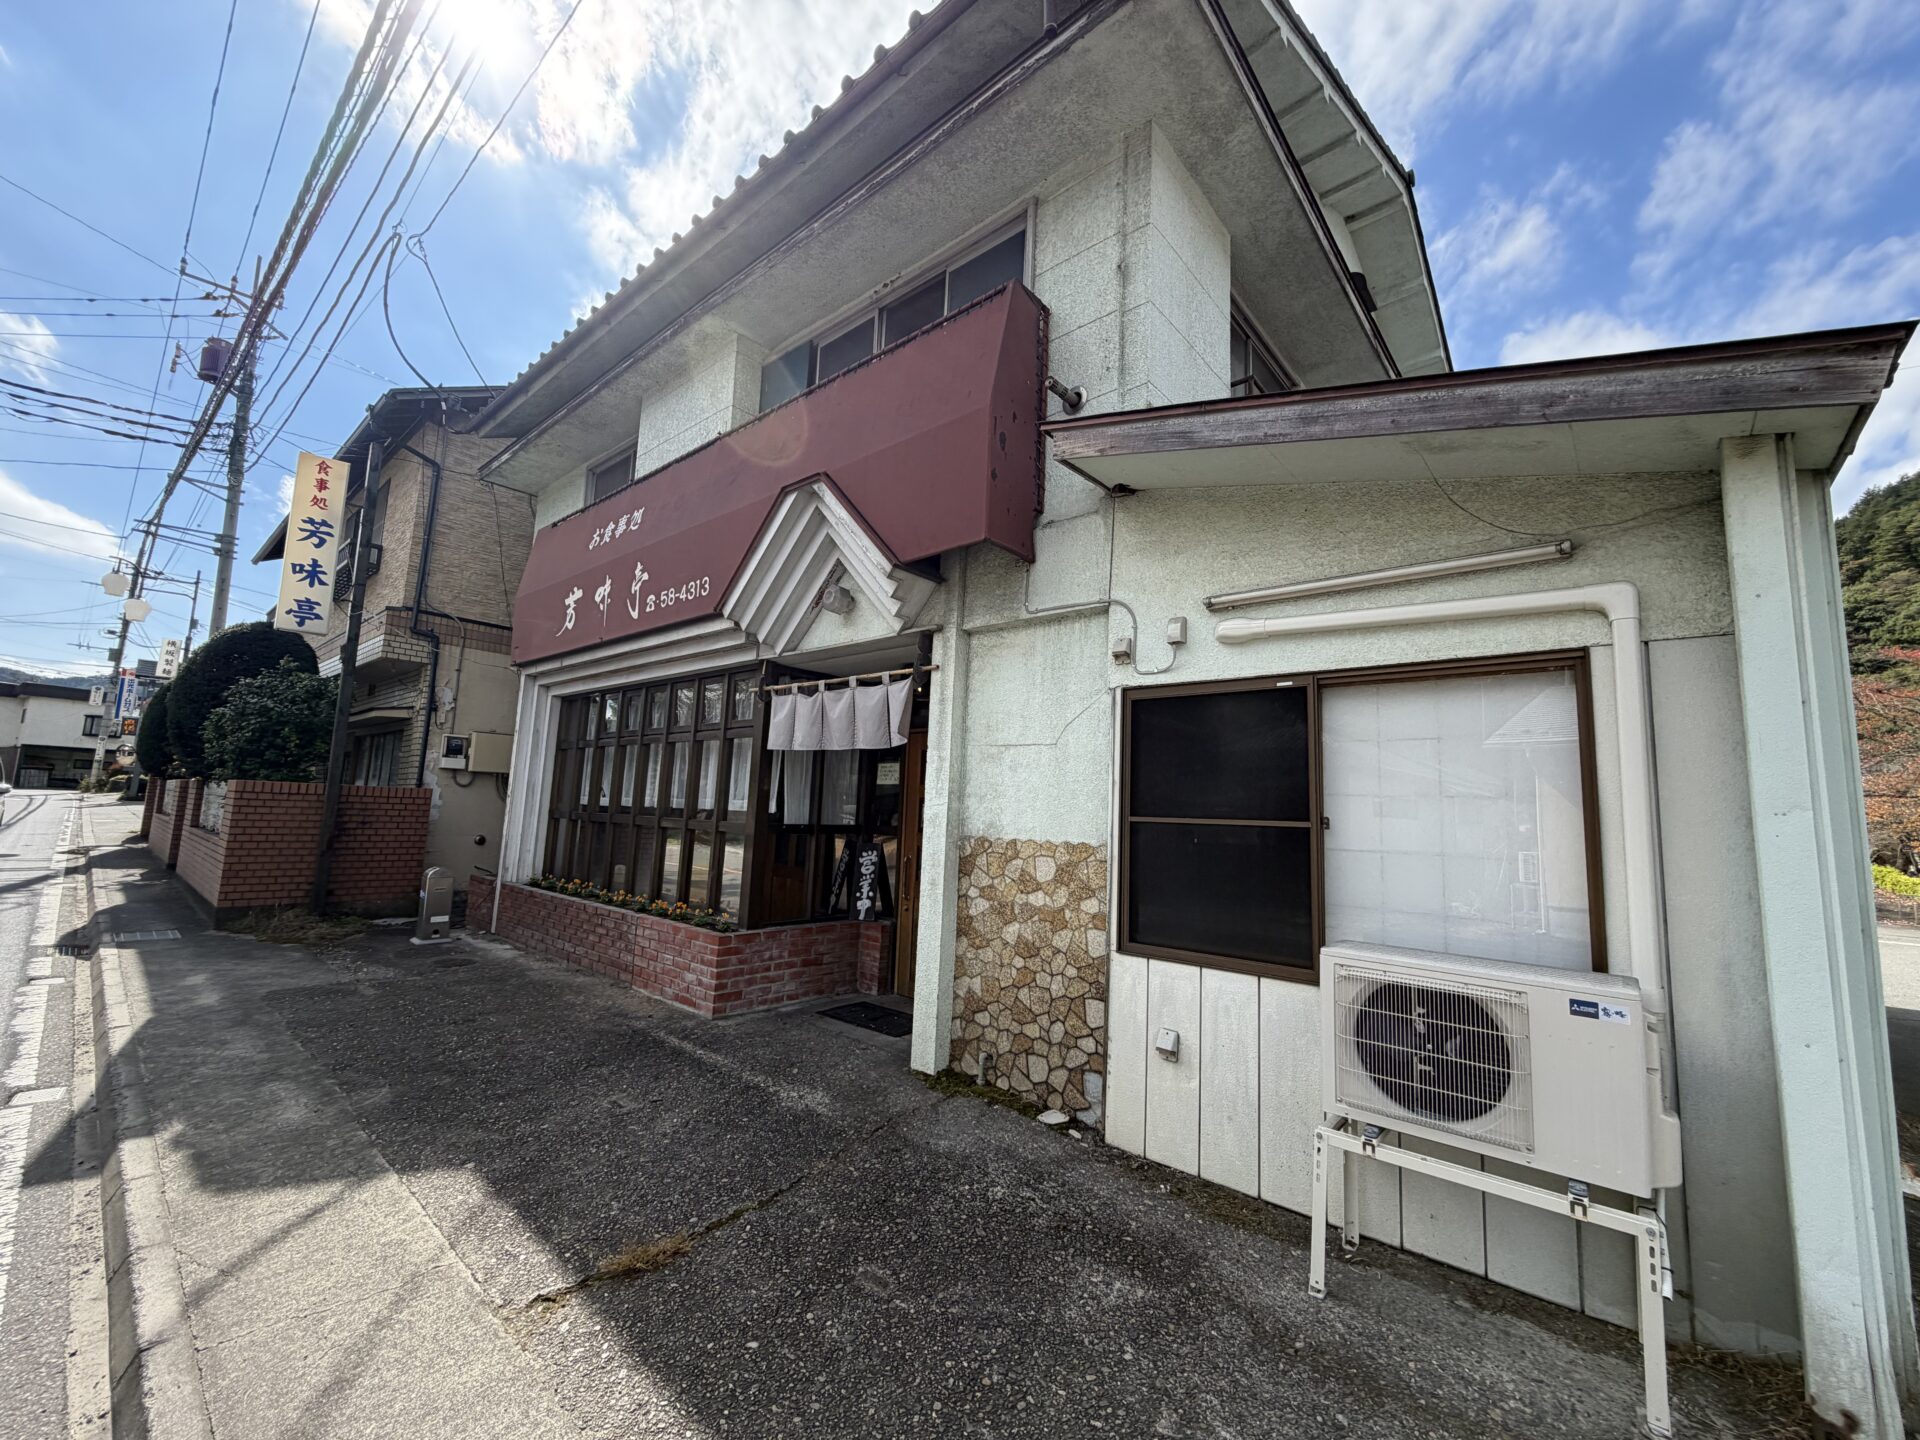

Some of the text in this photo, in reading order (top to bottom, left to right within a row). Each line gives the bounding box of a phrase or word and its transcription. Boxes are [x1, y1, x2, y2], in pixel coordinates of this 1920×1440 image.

[309, 460, 333, 511] 食事処
[588, 506, 645, 551] お食事処
[284, 516, 336, 628] 芳味亭
[555, 561, 649, 637] 芳味亭
[855, 850, 878, 921] 営業中
